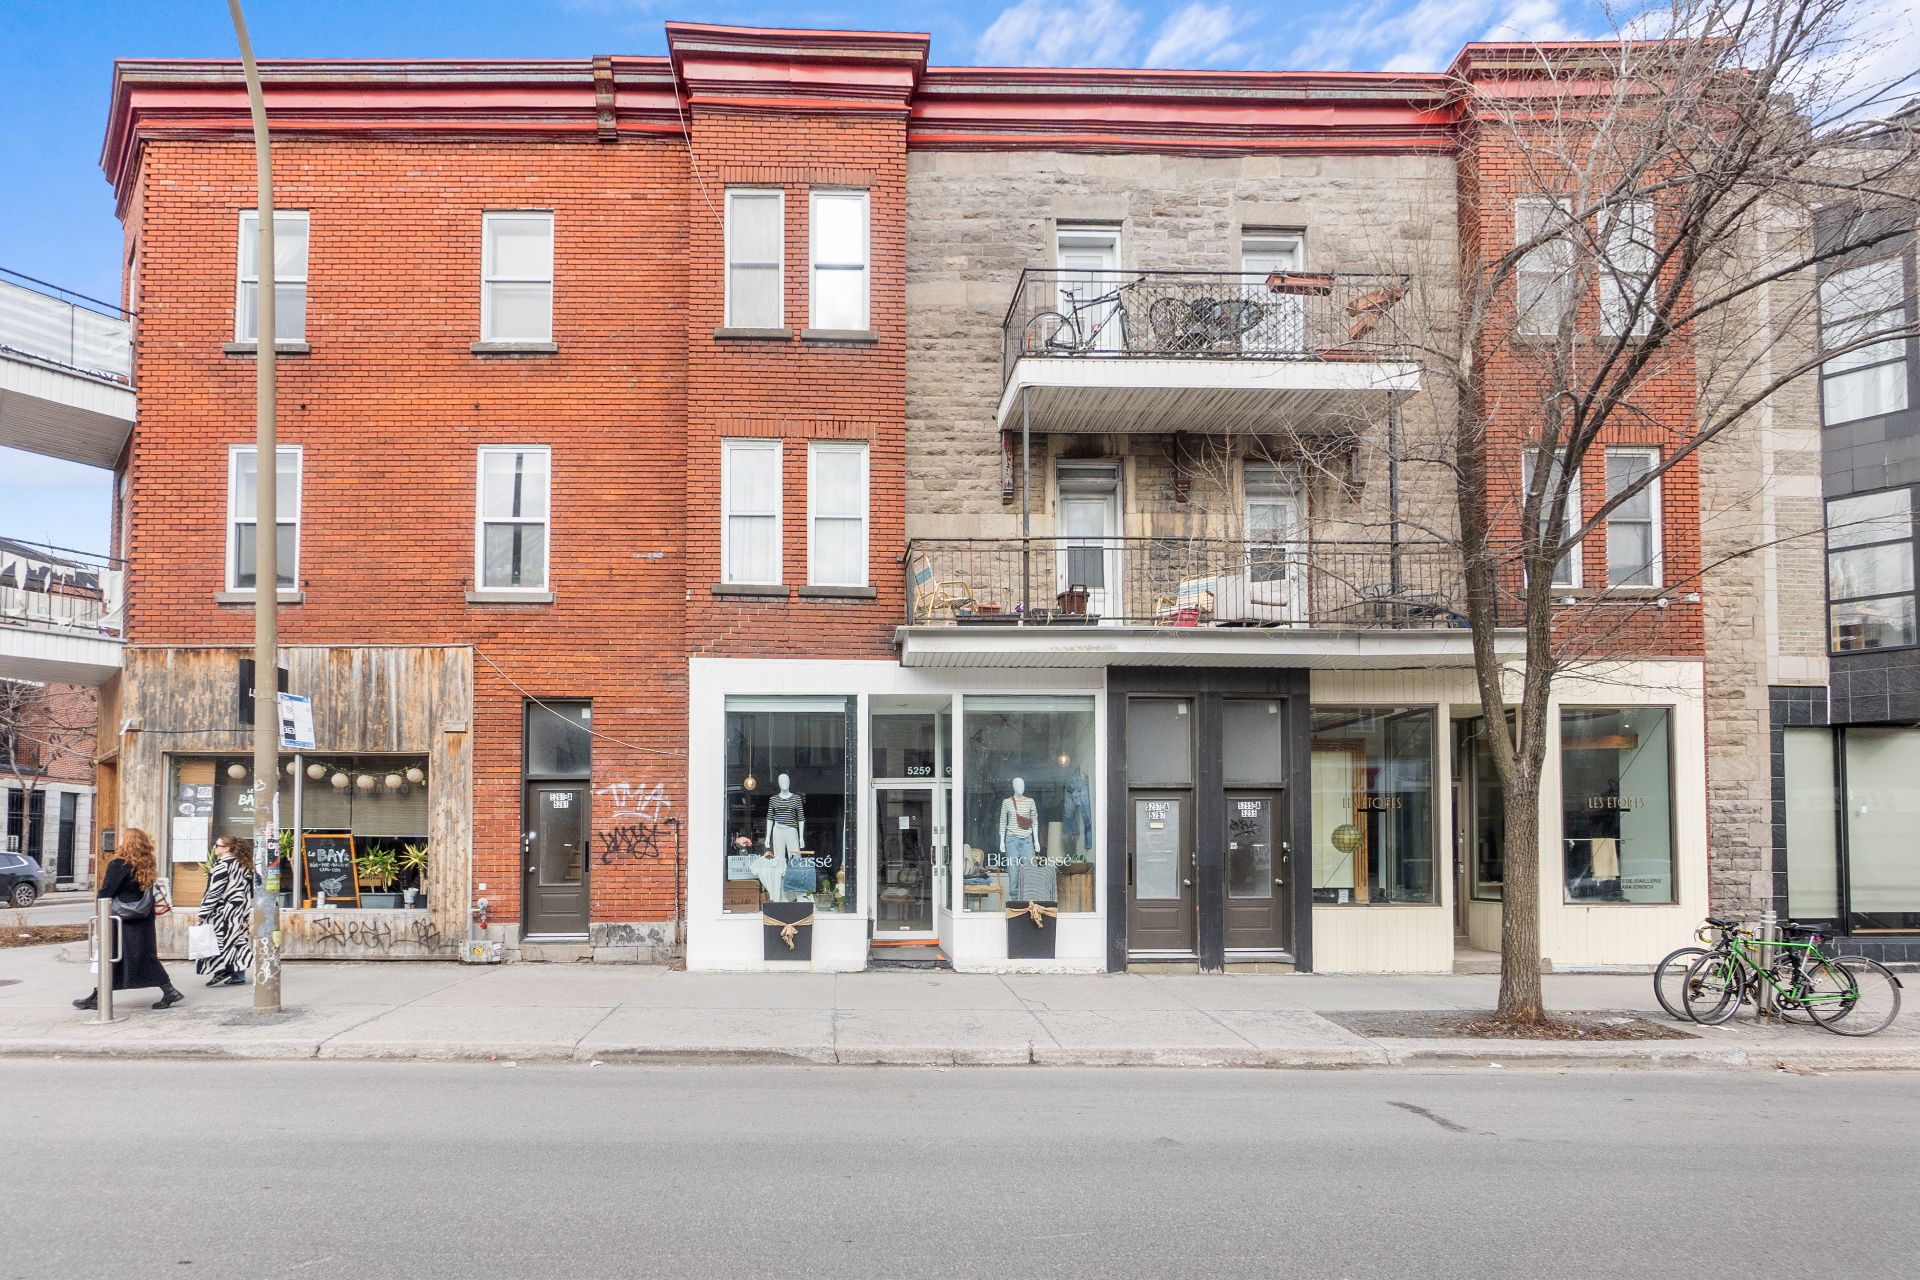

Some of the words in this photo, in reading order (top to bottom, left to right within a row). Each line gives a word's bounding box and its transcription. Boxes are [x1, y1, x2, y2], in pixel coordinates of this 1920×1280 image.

[283, 725, 296, 735] 363
[907, 766, 931, 775] 5259
[238, 794, 254, 806] BA
[1588, 796, 1604, 809] LES
[790, 854, 833, 868] cassé
[987, 853, 1027, 867] Blanc
[1030, 853, 1072, 867] cassé
